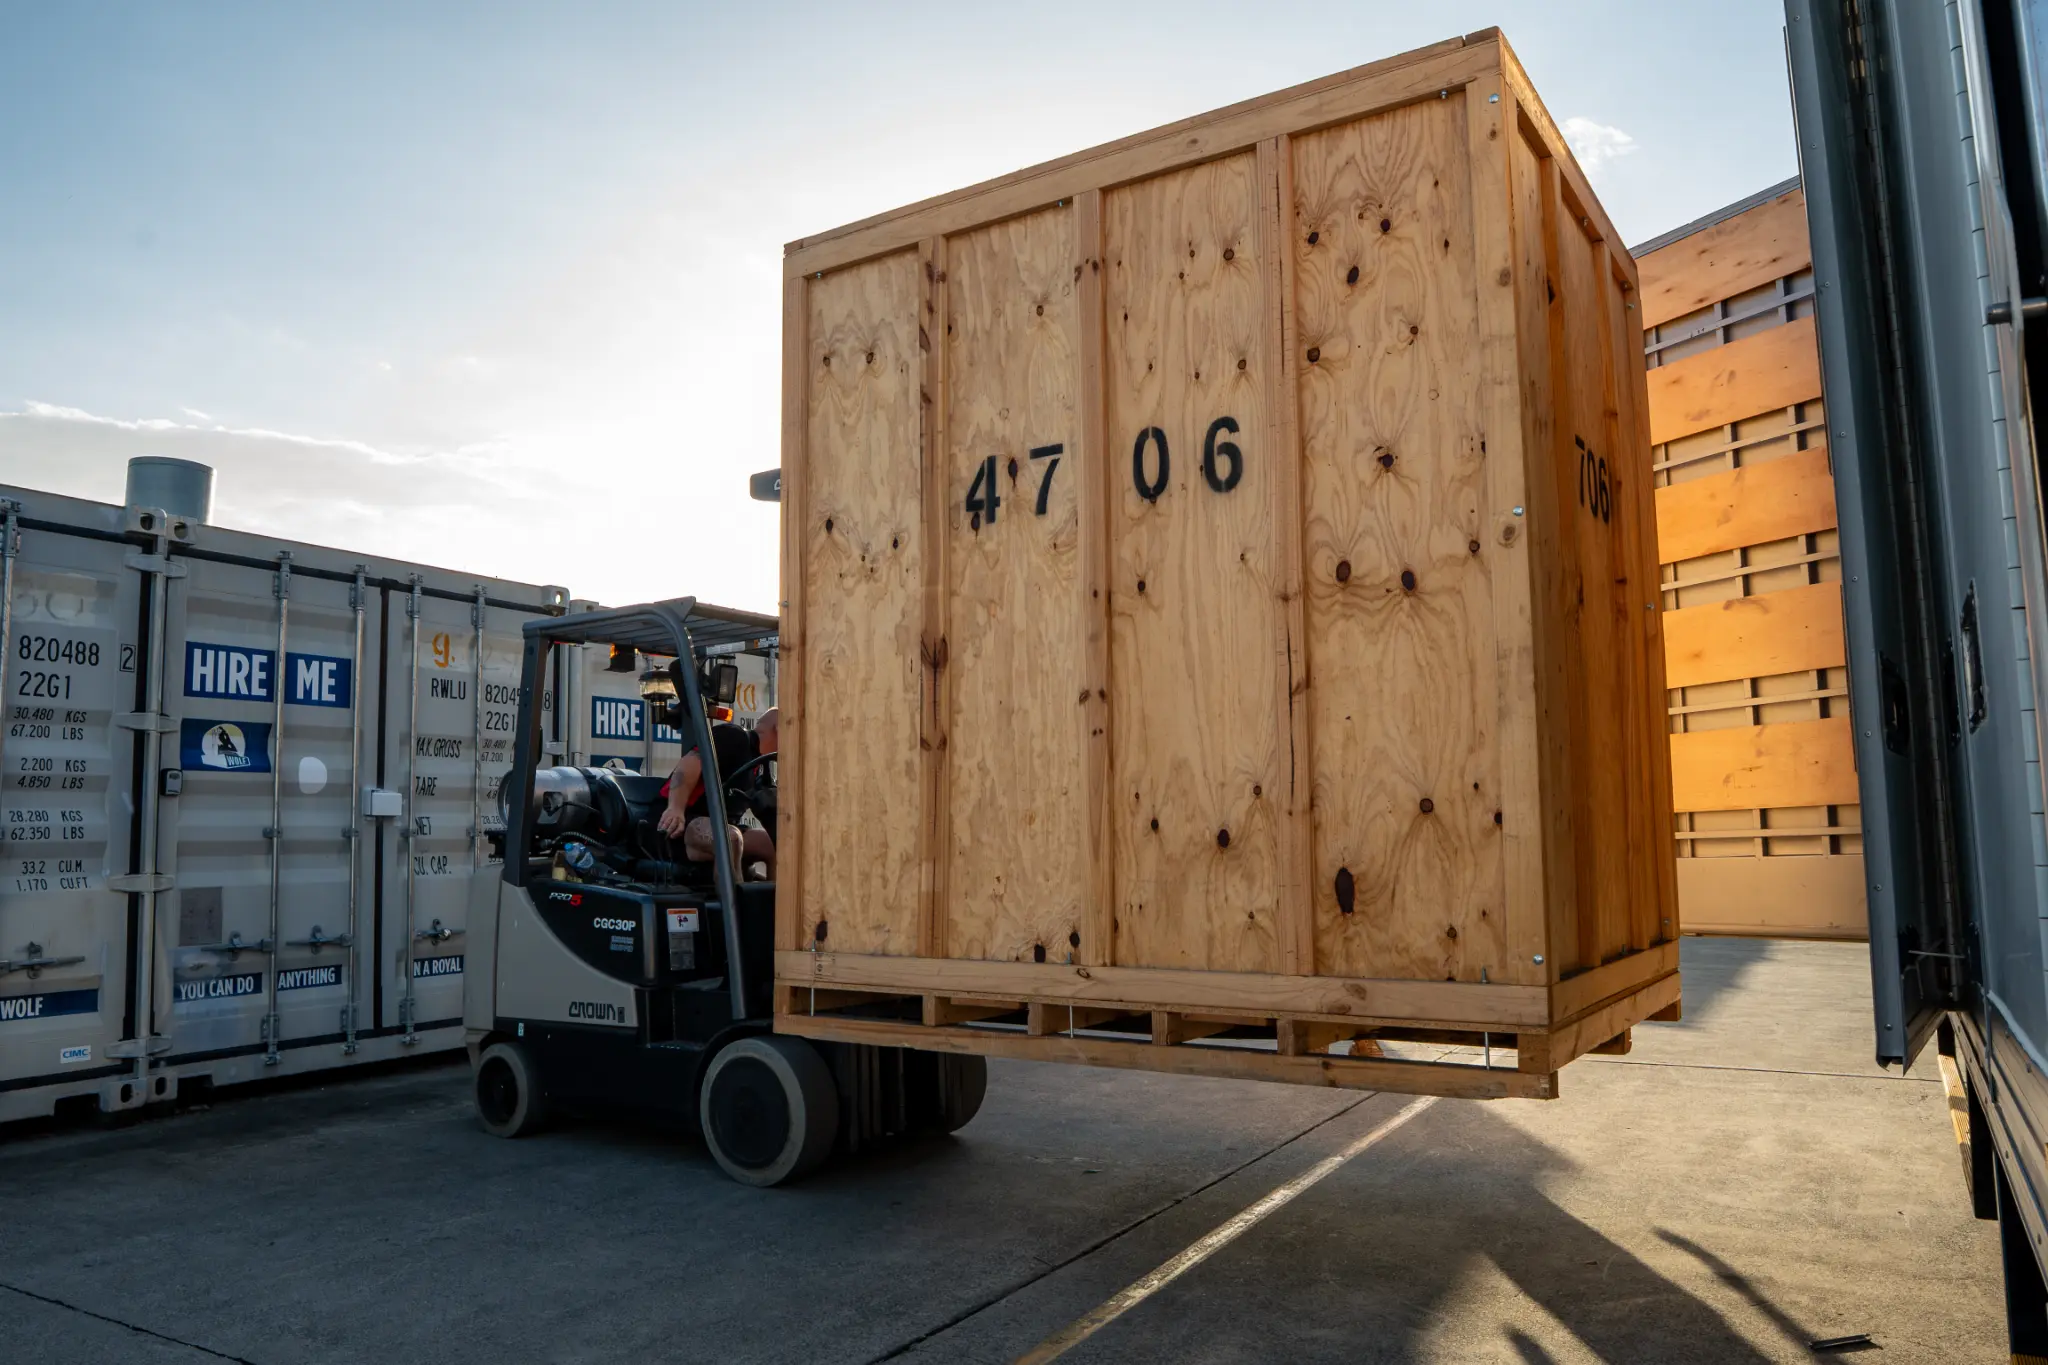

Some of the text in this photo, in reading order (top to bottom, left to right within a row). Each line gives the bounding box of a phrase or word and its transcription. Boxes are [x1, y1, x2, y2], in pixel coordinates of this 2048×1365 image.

[19, 635, 134, 671] 820488 2
[192, 648, 337, 702] HIRE ME
[19, 671, 71, 699] 22G1
[431, 677, 466, 700] RWLU
[14, 706, 87, 723] 30.480 KGS
[595, 701, 641, 737] HIRE
[11, 724, 84, 741] 67.200 LBS
[21, 758, 87, 772] 2.200 KGS
[18, 776, 84, 789] 4.850 LBS
[416, 776, 437, 796] TARE
[9, 810, 83, 823] 28.280 KGS
[11, 827, 84, 840] 62.350 LBS
[21, 861, 46, 875] 33.2
[16, 878, 48, 892] 1.170
[593, 917, 636, 932] CGC30P
[423, 960, 430, 976] A
[432, 957, 462, 975] ROYAL
[180, 967, 335, 1000] YOU CAN DO ANYTHING
[0, 997, 43, 1019] WOLF
[569, 1001, 615, 1020] CROWN
[63, 1048, 88, 1059] CIMC
